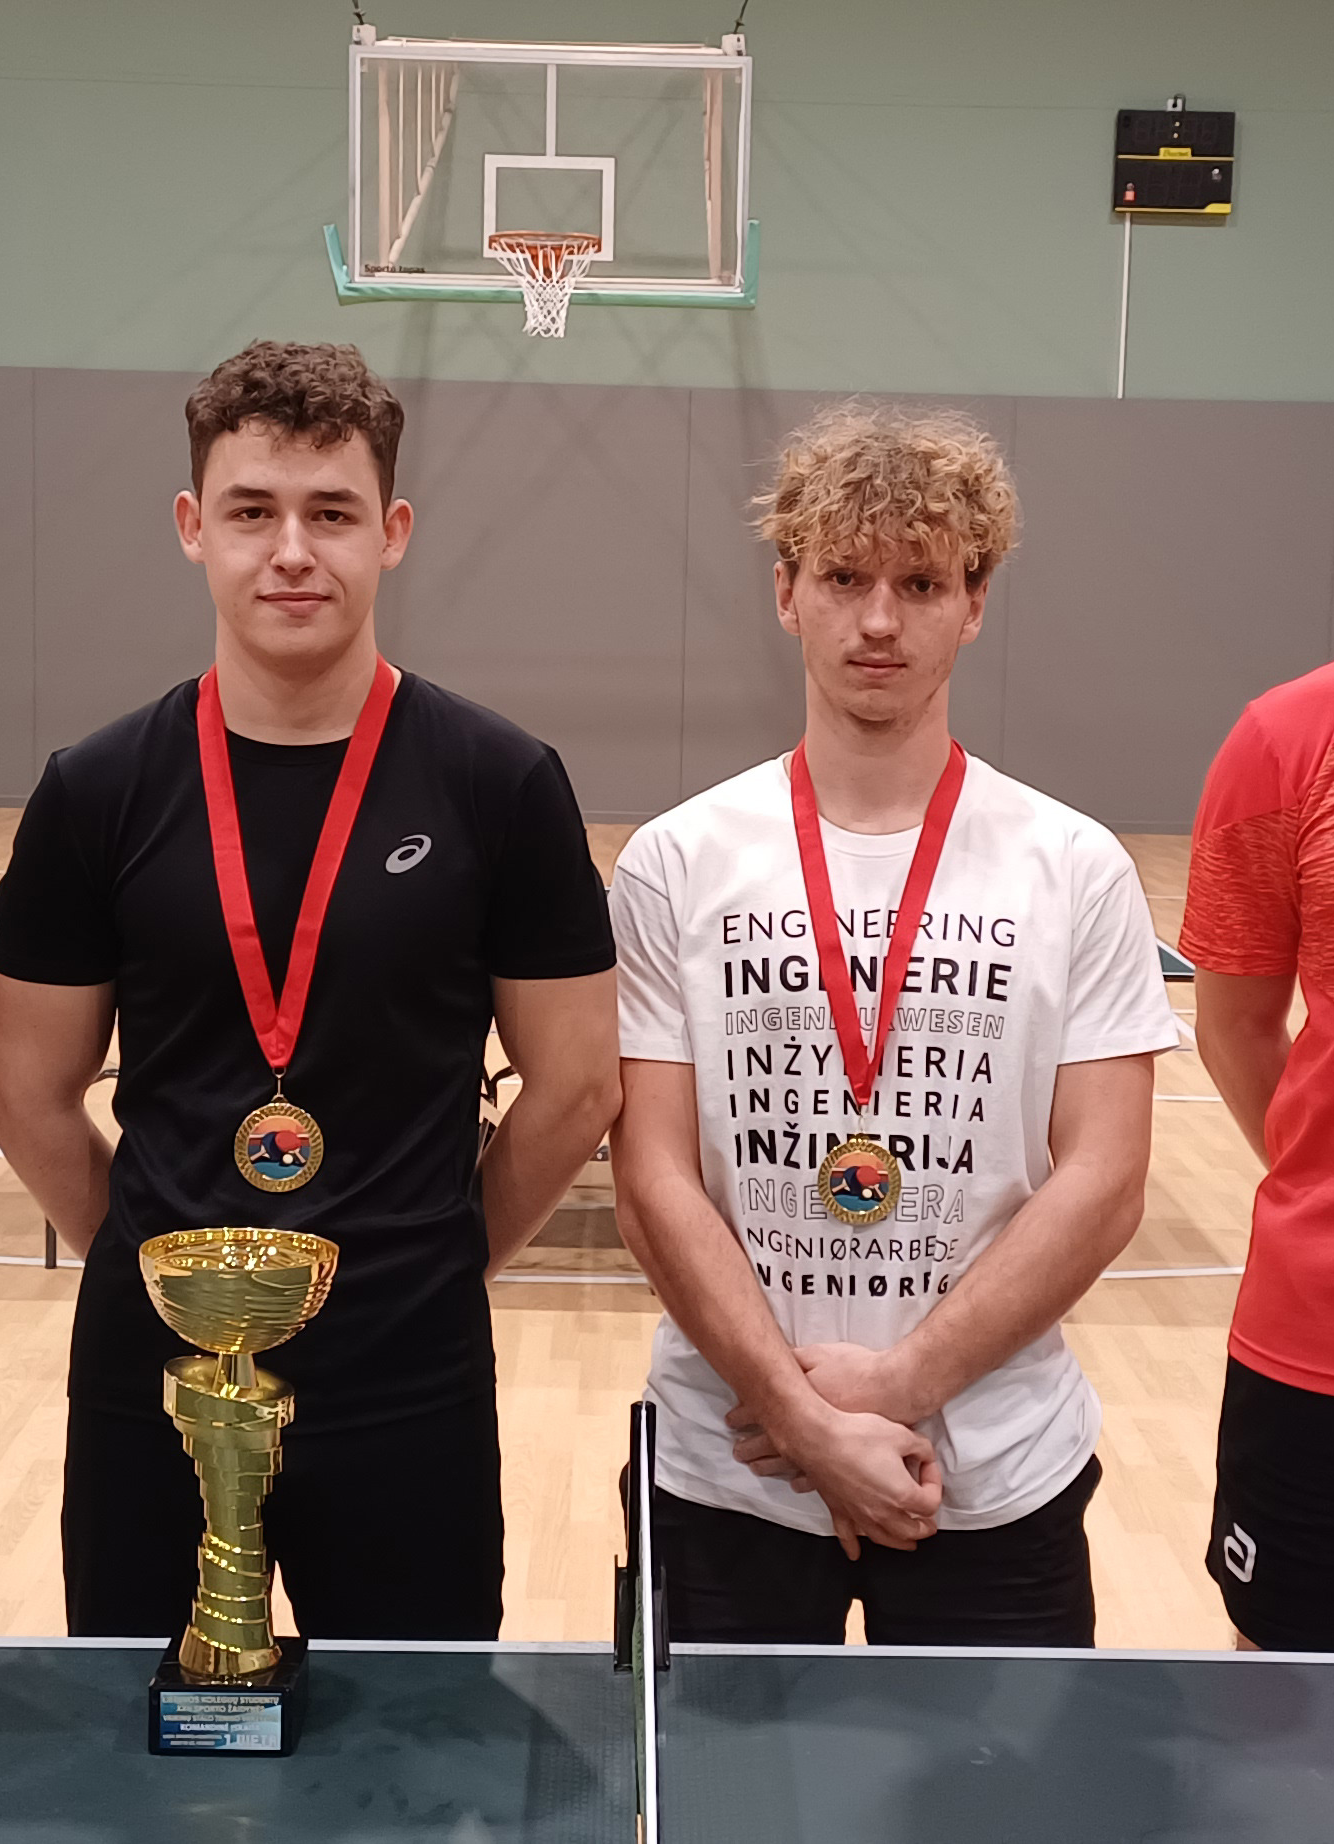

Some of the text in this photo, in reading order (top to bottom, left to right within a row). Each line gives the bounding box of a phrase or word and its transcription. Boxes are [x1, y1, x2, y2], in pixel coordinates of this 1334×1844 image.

[723, 909, 1015, 947] ENGNEERING
[724, 955, 1012, 1002] INGNERIE
[726, 1006, 1004, 1039] INGENUWESEN
[727, 1036, 992, 1083] INŻYIERIA
[734, 1122, 974, 1175] INŽIRIJA
